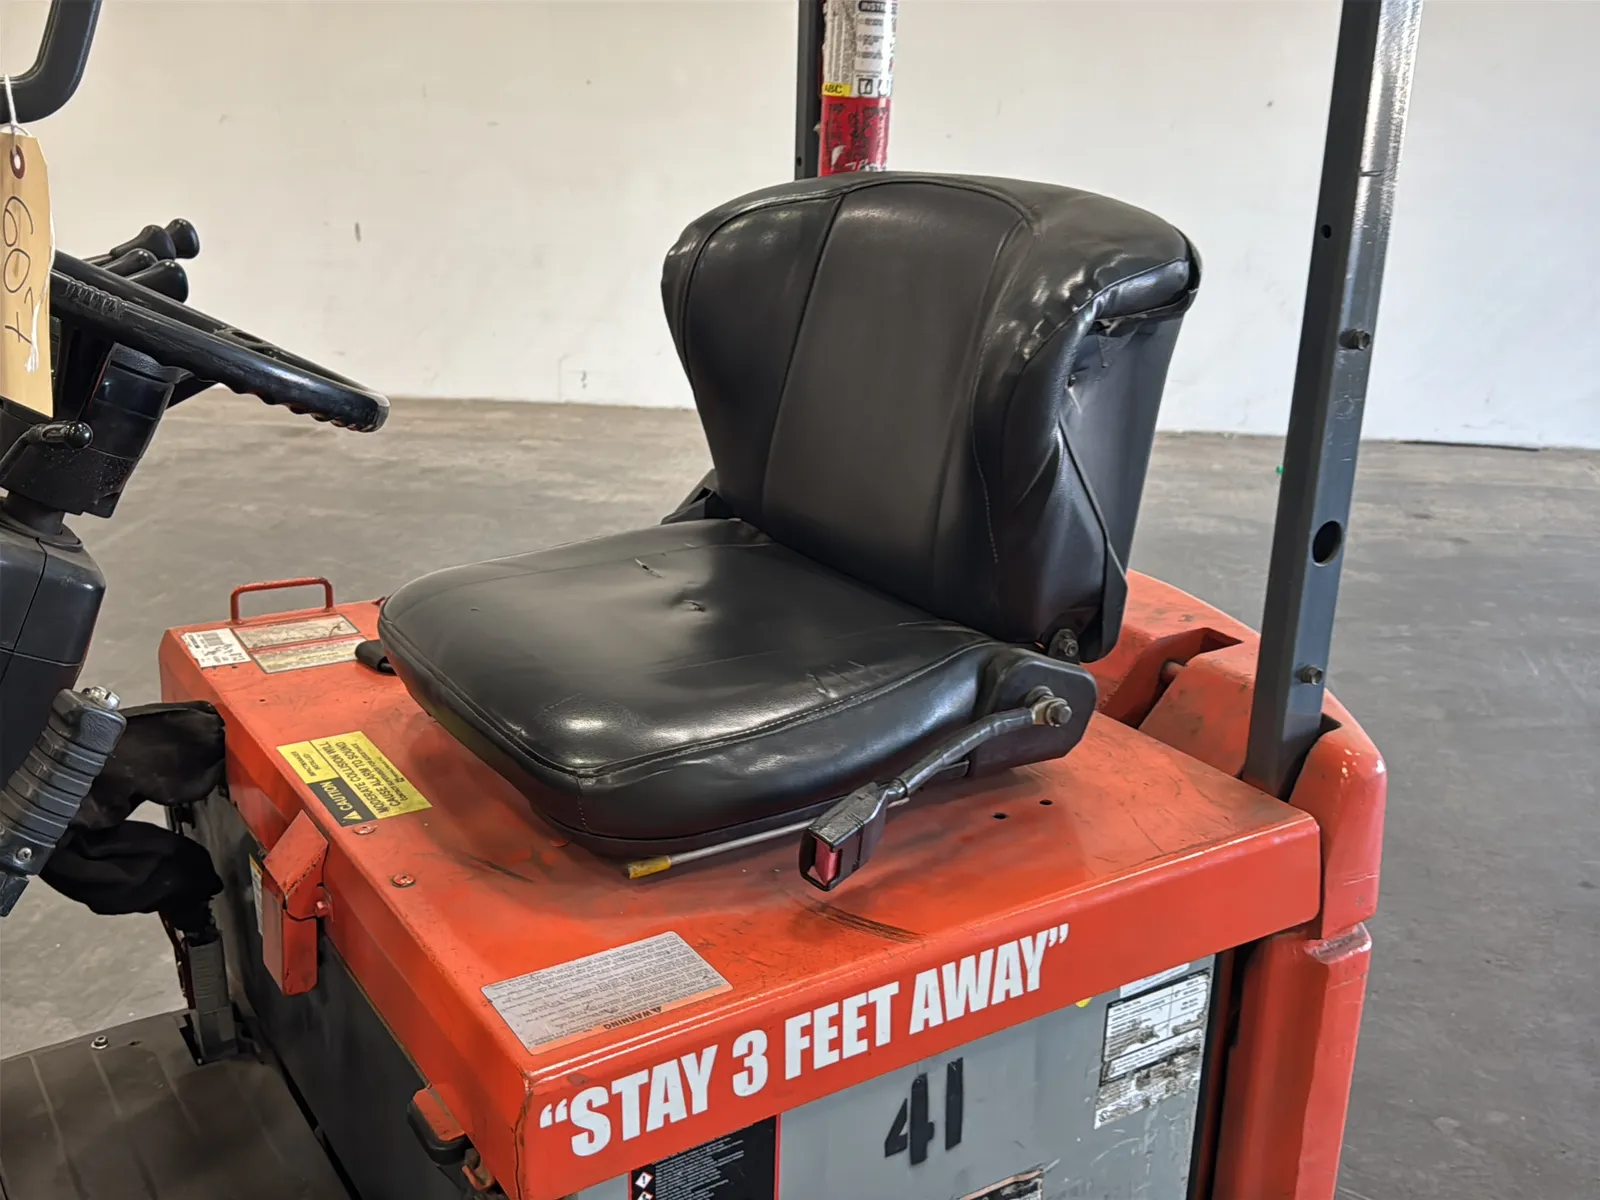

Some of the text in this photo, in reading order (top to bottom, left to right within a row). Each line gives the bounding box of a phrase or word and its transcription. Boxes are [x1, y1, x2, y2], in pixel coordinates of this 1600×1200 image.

[824, 84, 843, 94] ABC
[318, 741, 337, 754] WILL
[334, 741, 358, 759] SOUND
[329, 753, 361, 782] COLLISION
[350, 759, 365, 767] TO
[358, 767, 383, 787] ALARM
[318, 780, 354, 811] CAUTION
[353, 781, 389, 813] MODERATE
[375, 786, 401, 806] CAUSE
[602, 1010, 653, 1030] WARNING
[733, 1030, 768, 1096] 3
[785, 982, 899, 1080] FEET
[885, 1057, 963, 1165] 41
